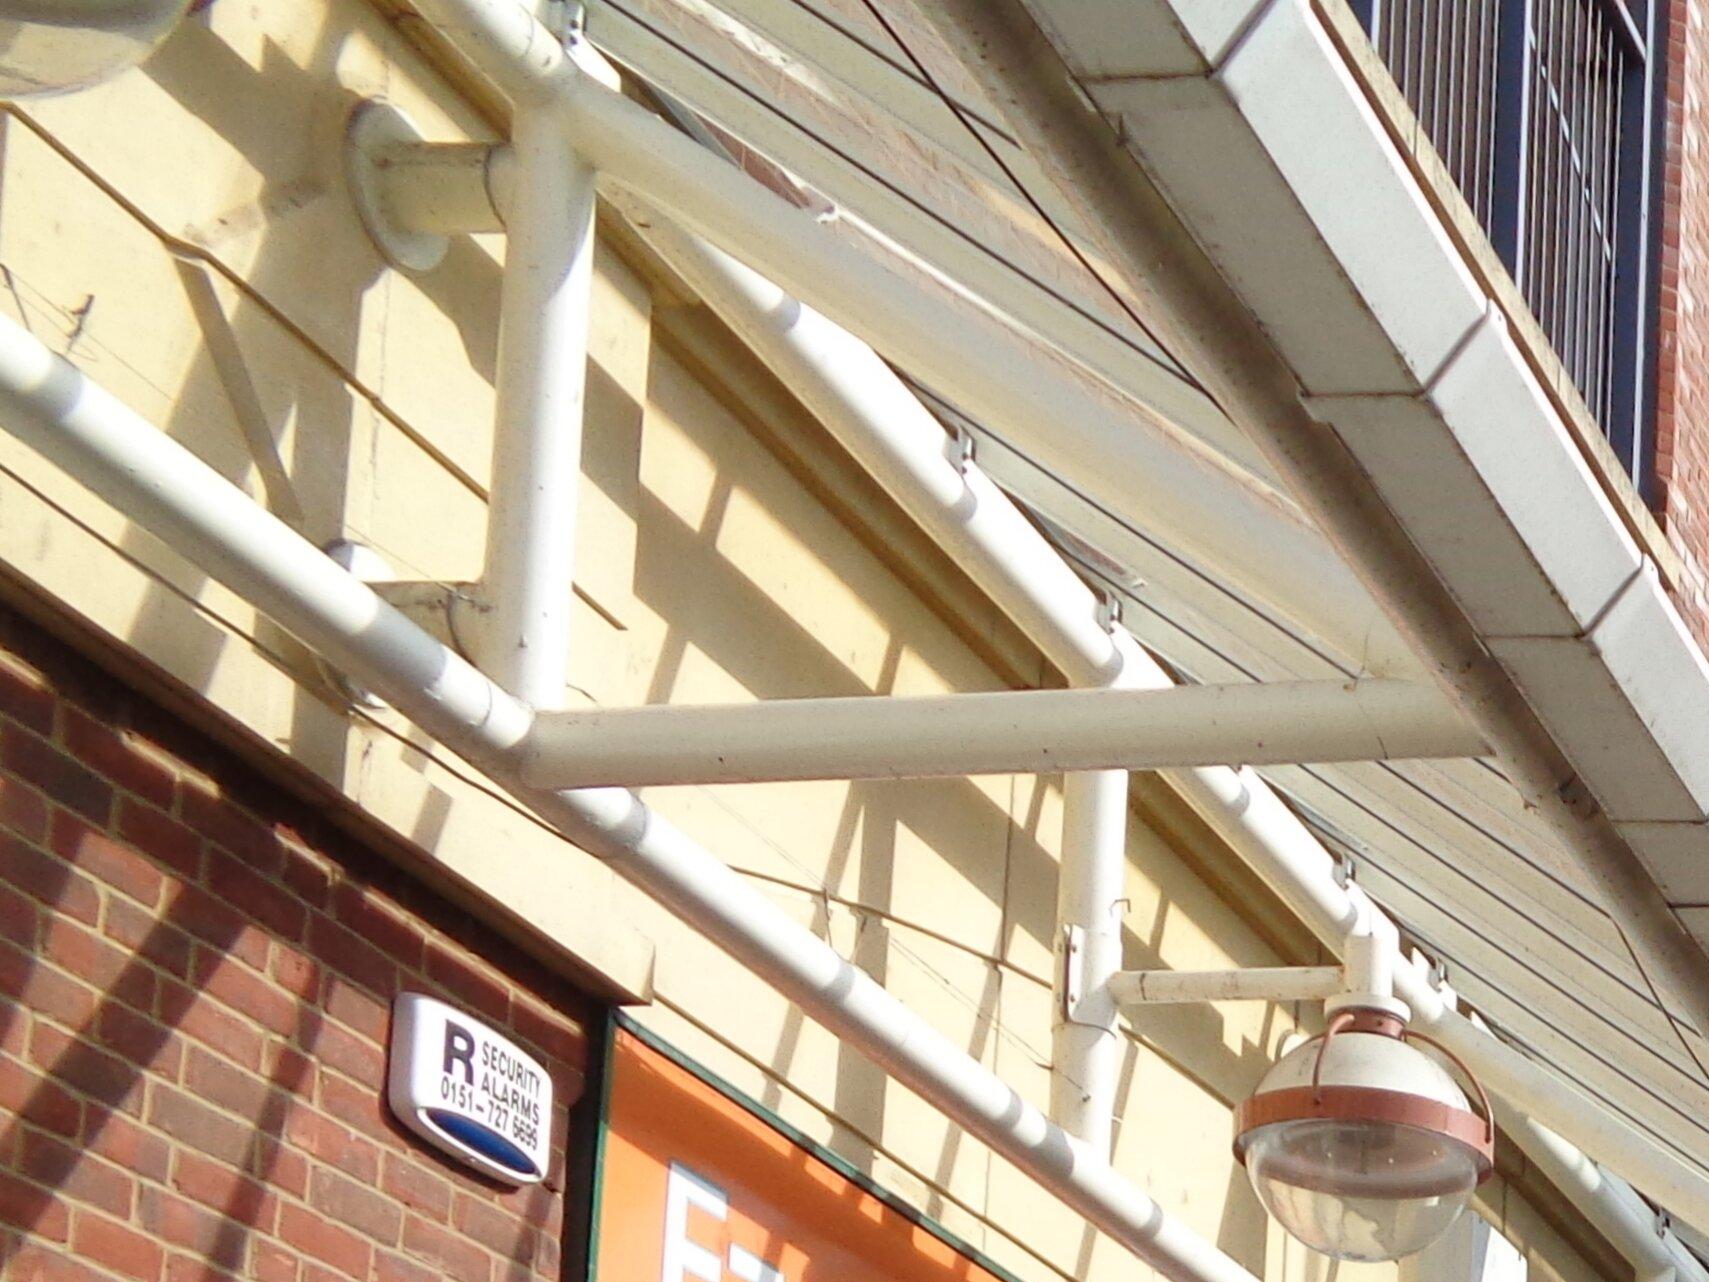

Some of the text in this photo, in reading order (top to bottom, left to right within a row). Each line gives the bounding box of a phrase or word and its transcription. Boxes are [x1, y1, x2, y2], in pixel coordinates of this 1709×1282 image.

[443, 1019, 476, 1086] R
[481, 1039, 541, 1094] SECURITY
[480, 1073, 540, 1126] ALARMS
